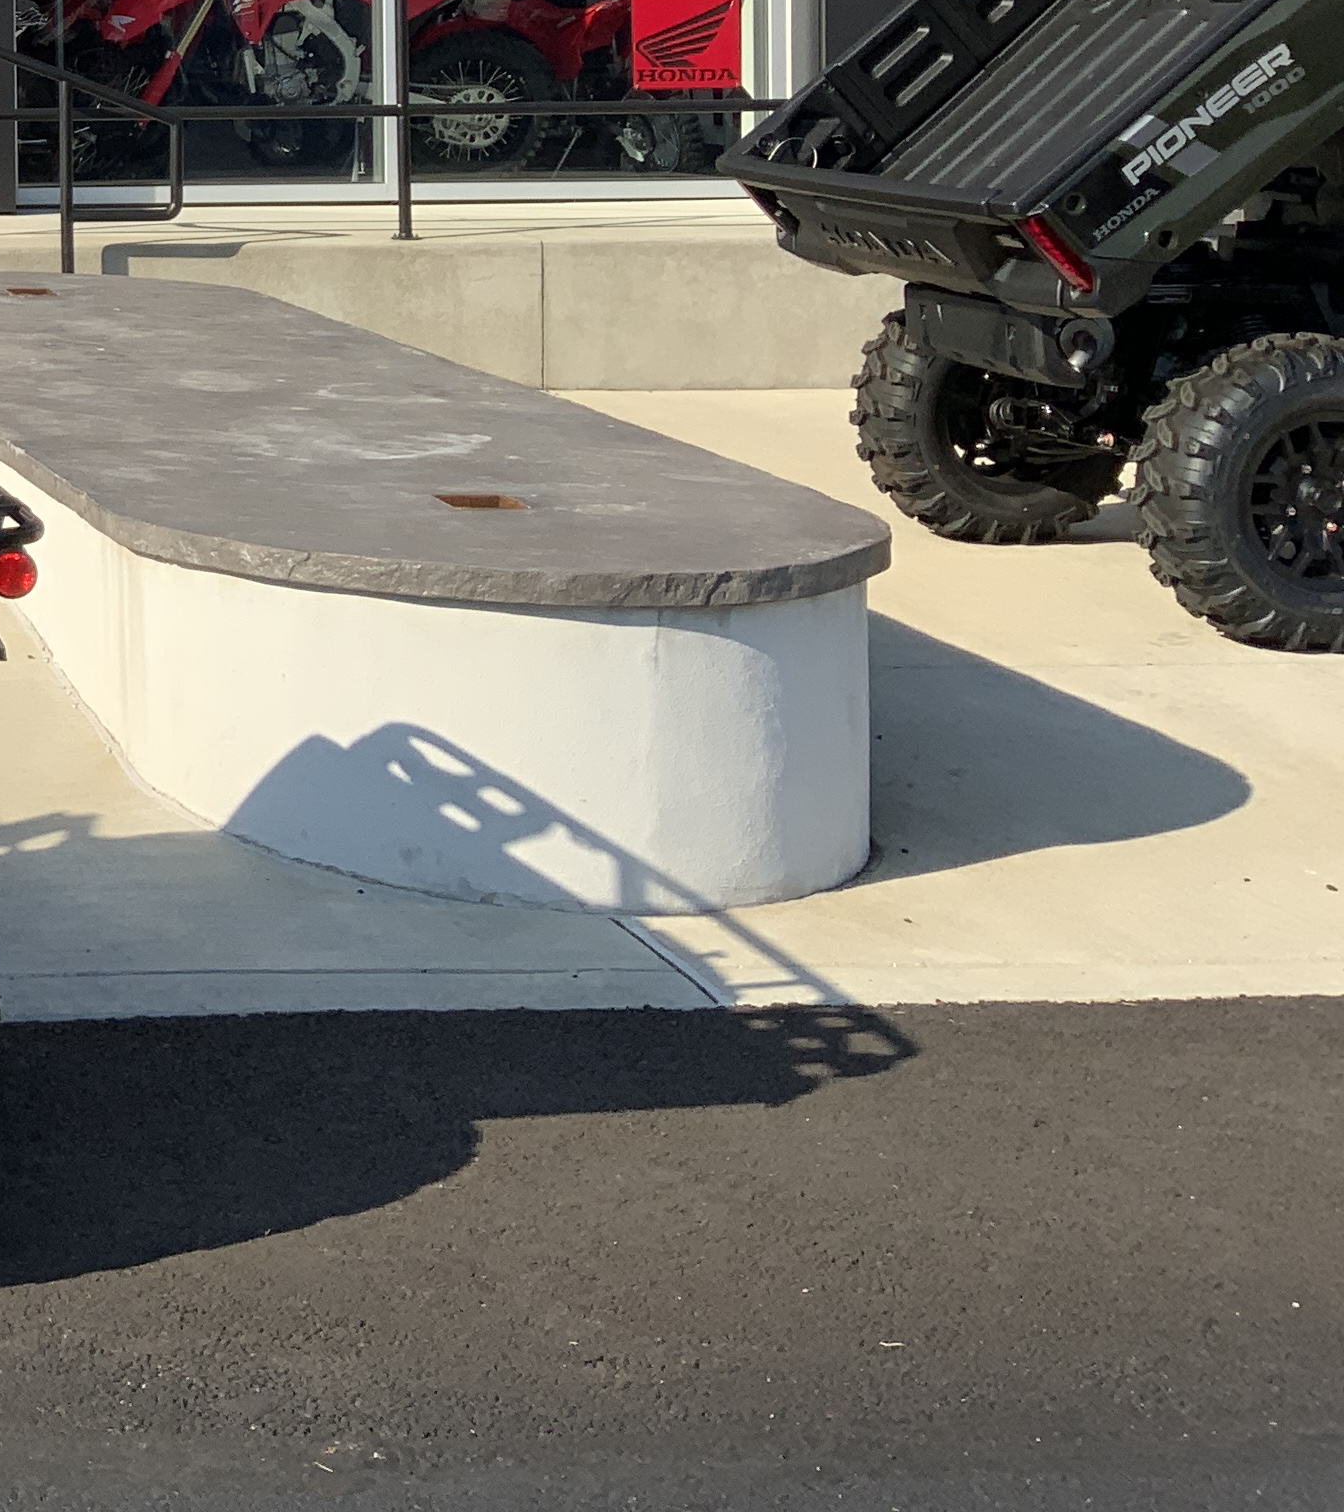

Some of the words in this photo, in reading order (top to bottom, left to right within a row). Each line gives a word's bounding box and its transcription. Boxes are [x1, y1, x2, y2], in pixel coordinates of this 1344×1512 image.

[637, 68, 739, 83] HONDA
[1242, 66, 1306, 114] 1000
[1121, 43, 1295, 187] PIONEER
[1091, 186, 1160, 242] HONDA
